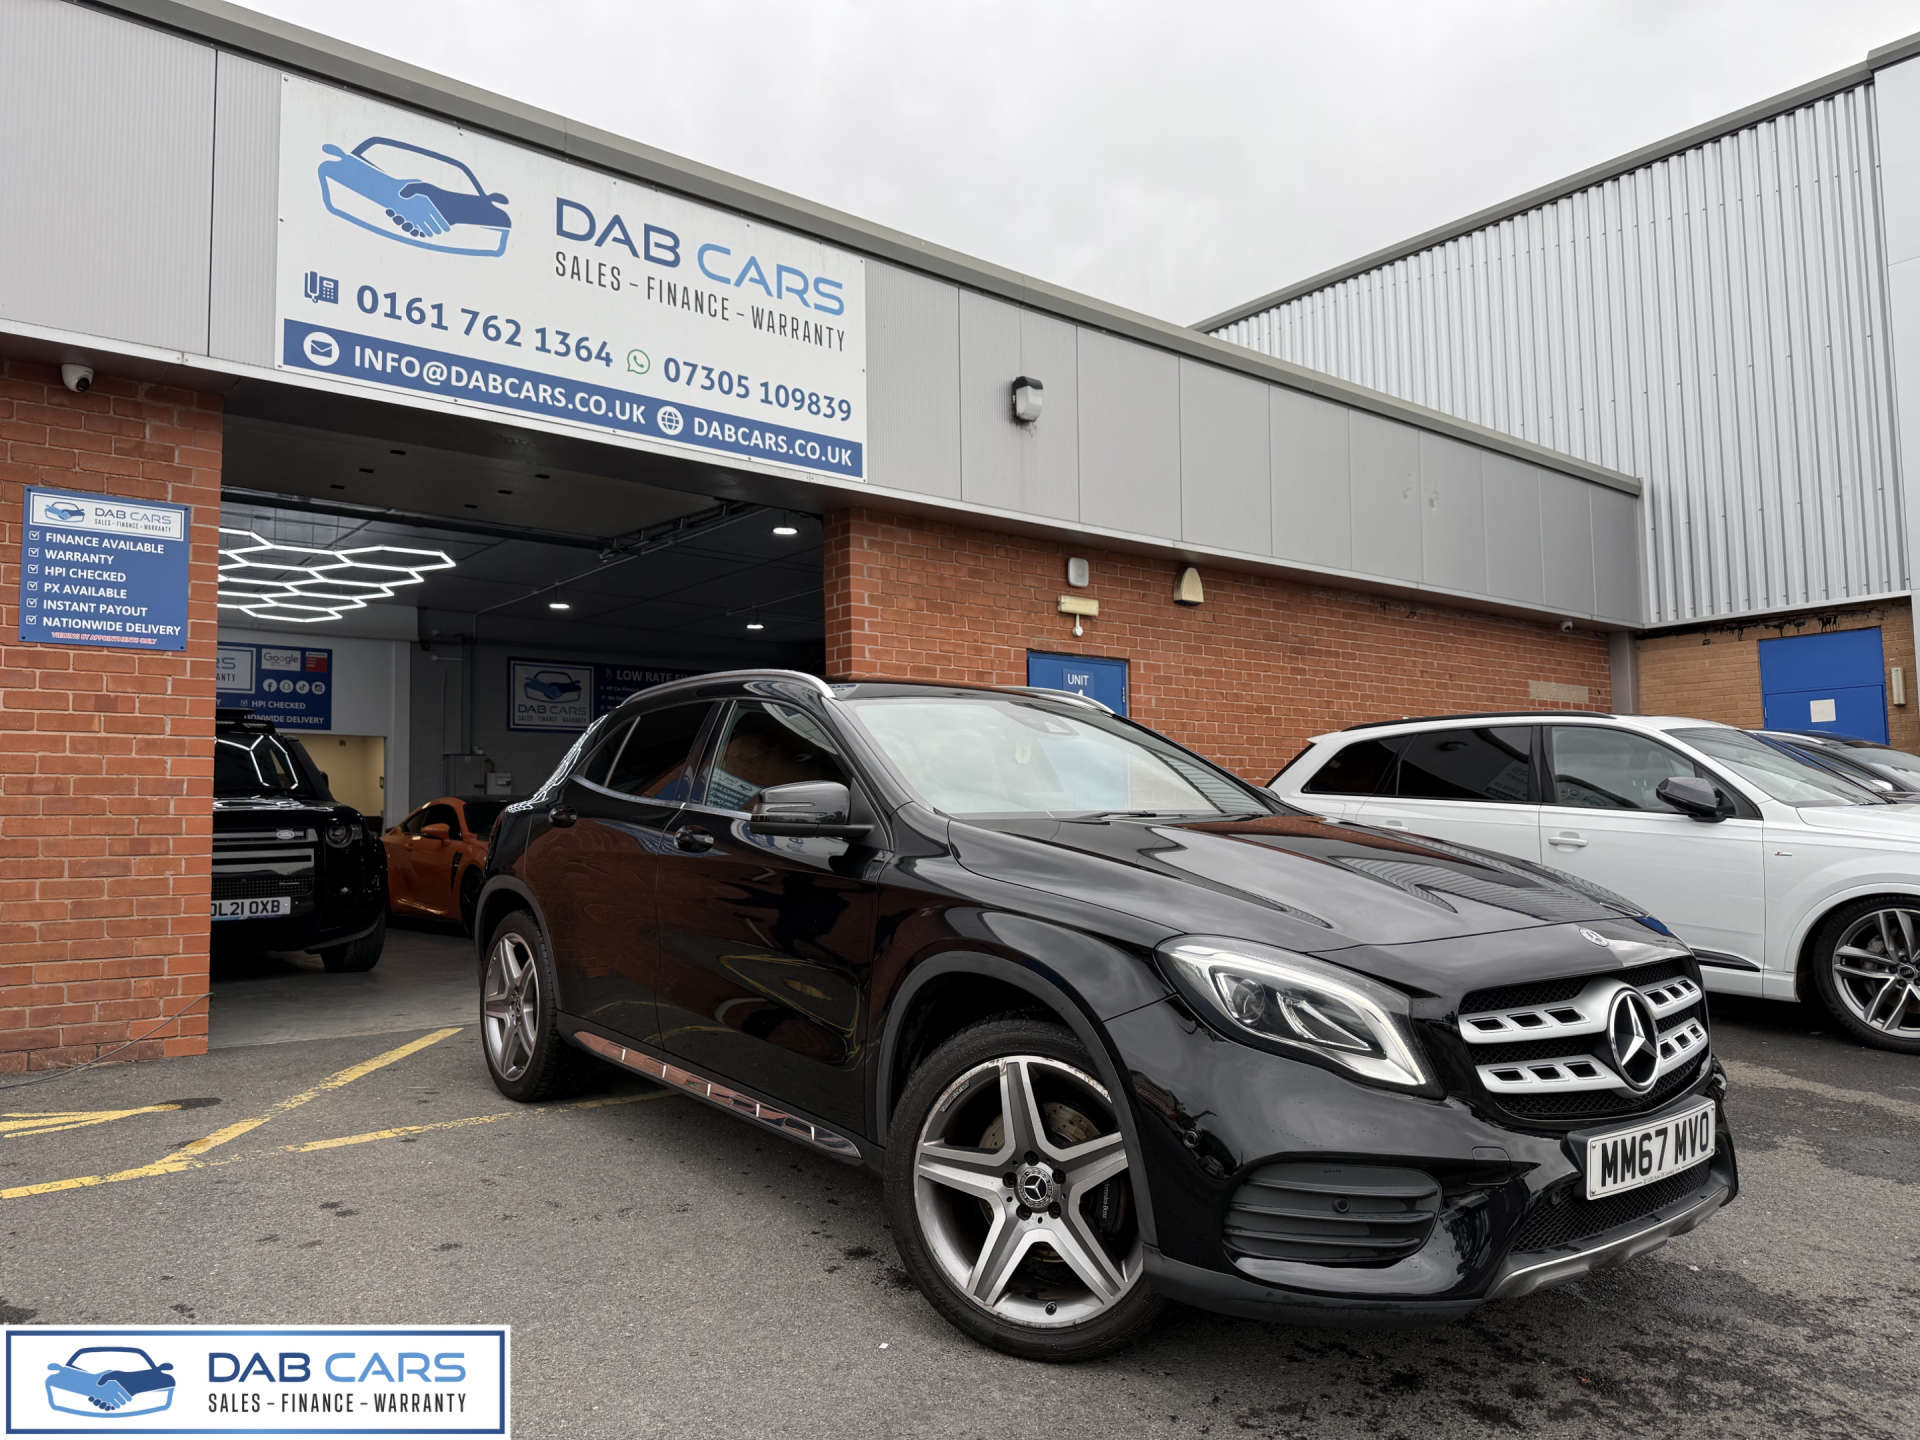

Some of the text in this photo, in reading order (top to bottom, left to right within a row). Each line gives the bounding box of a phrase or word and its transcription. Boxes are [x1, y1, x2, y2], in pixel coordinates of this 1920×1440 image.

[556, 197, 845, 316] DAB CARS
[555, 251, 621, 292] SALES
[647, 276, 729, 321] FINANCE
[751, 305, 845, 352] WARRANTY
[356, 284, 852, 422] 0161 762 1364 07305 109839
[354, 345, 852, 467] INFO@DABCARS.CO.UK DABCARS.CO.UK
[95, 507, 172, 525] DAB CARS
[45, 532, 165, 554] FINANCE AVAILABLE
[45, 549, 114, 565] WARRANTY
[44, 566, 127, 583] HPI CHECKED
[44, 583, 127, 599] PX AVAILABLE
[43, 600, 148, 617] INSTANT PAYOUT
[42, 617, 181, 636] NATIONWIDE DELIVERY
[263, 652, 298, 665] Google
[616, 670, 644, 681] LOW
[645, 671, 671, 682] RATE
[1067, 673, 1089, 686] UNIT
[251, 700, 266, 708] HPI
[267, 700, 306, 710] CHECKED
[518, 704, 588, 716] DAB CARS
[286, 715, 325, 724] DELIVERY
[249, 900, 280, 914] OXB
[1601, 1111, 1709, 1187] MM67 MVO
